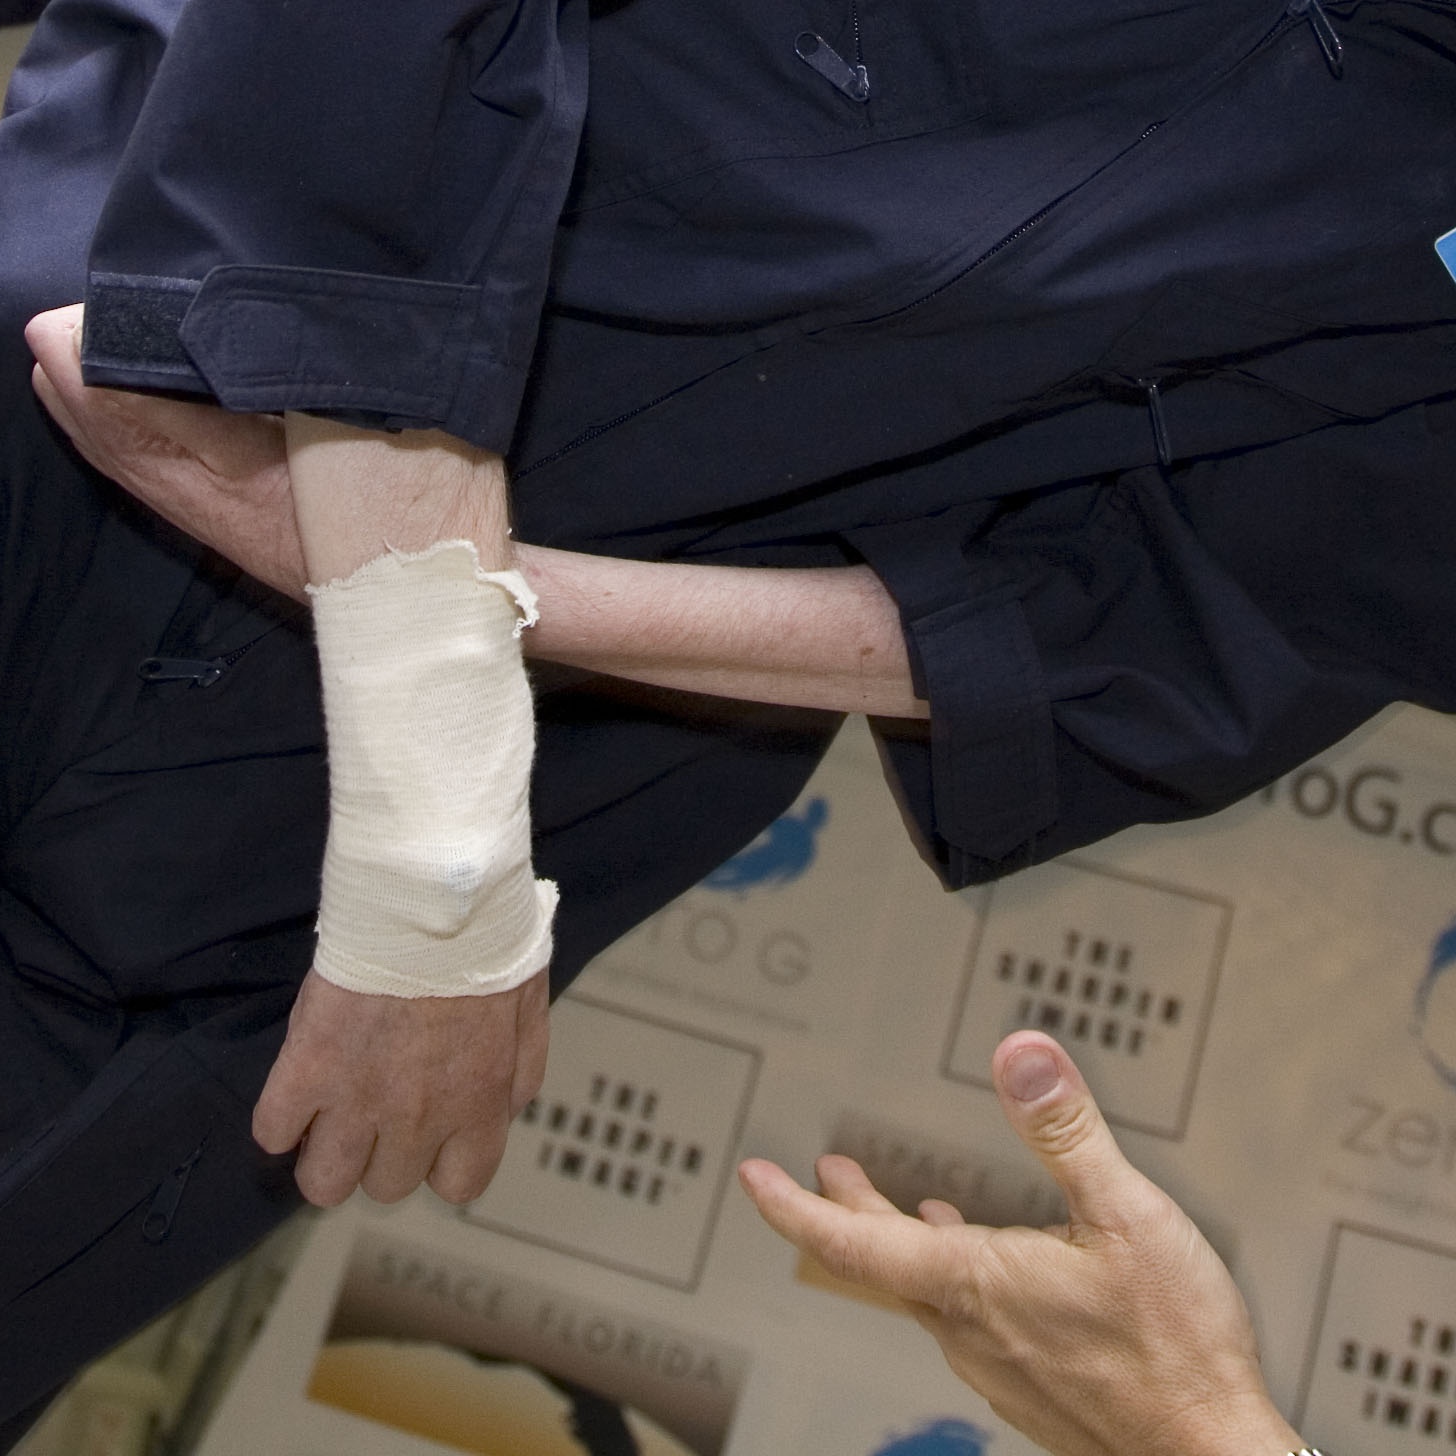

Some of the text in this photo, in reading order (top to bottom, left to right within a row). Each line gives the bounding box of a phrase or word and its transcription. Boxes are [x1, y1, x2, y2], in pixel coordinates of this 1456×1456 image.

[1064, 928, 1132, 973] THE
[998, 950, 1182, 1025] SHARPER
[1017, 997, 1144, 1057] IMAGE
[591, 1074, 658, 1120] THE
[538, 1139, 665, 1207] IMAGE
[373, 1250, 507, 1323] SPACE
